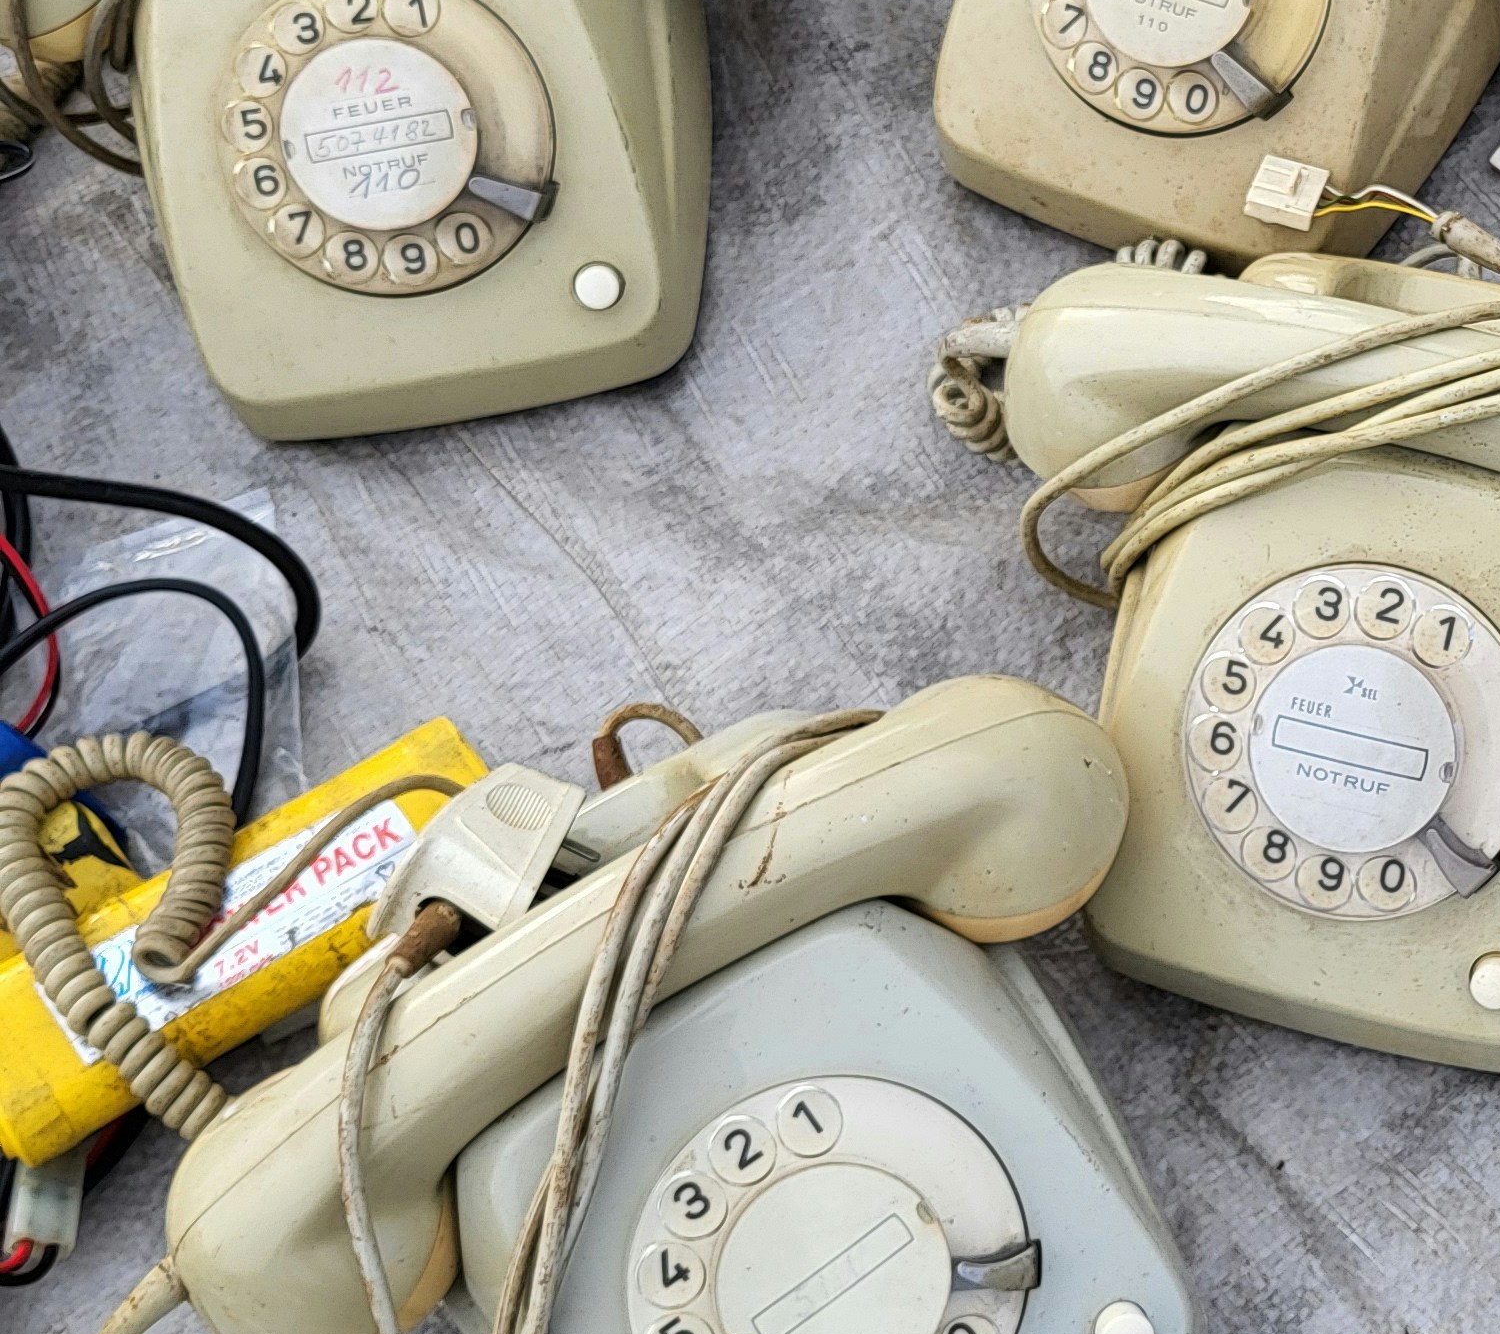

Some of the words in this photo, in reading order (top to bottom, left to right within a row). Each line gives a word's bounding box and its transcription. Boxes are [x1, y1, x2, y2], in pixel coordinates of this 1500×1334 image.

[293, 12, 319, 44] 3
[1136, 14, 1168, 33] 110
[259, 54, 283, 86] 4
[1059, 3, 1084, 34] 7
[1088, 51, 1112, 81] 8
[1132, 78, 1157, 109] 9
[1186, 84, 1209, 114] 0
[335, 67, 399, 95] 112
[240, 108, 268, 140] 5
[332, 96, 412, 120] FEUER
[254, 165, 278, 197] 6
[342, 154, 429, 179] NOTRUF
[349, 168, 421, 199] 110
[288, 211, 312, 244] 7
[455, 223, 479, 254] 0
[343, 239, 367, 271] 8
[400, 244, 425, 274] 9
[1315, 587, 1342, 621] 3
[1376, 588, 1404, 625] 2
[1260, 615, 1285, 649] 4
[1439, 616, 1456, 651] 1
[1222, 660, 1248, 695] 5
[1361, 687, 1378, 701] SEL
[1290, 697, 1332, 718] FEUER
[1210, 721, 1236, 755] 6
[1296, 763, 1391, 795] NOTRUF
[1226, 779, 1250, 813] 7
[310, 818, 403, 886] PACK
[1262, 830, 1289, 863] 8
[1317, 857, 1344, 891] 9
[1380, 859, 1405, 893] 0
[213, 939, 260, 978] 7.2V
[792, 1101, 823, 1134] 1
[724, 1128, 764, 1170] 2
[673, 1182, 711, 1220] 3
[660, 1249, 691, 1289] 4
